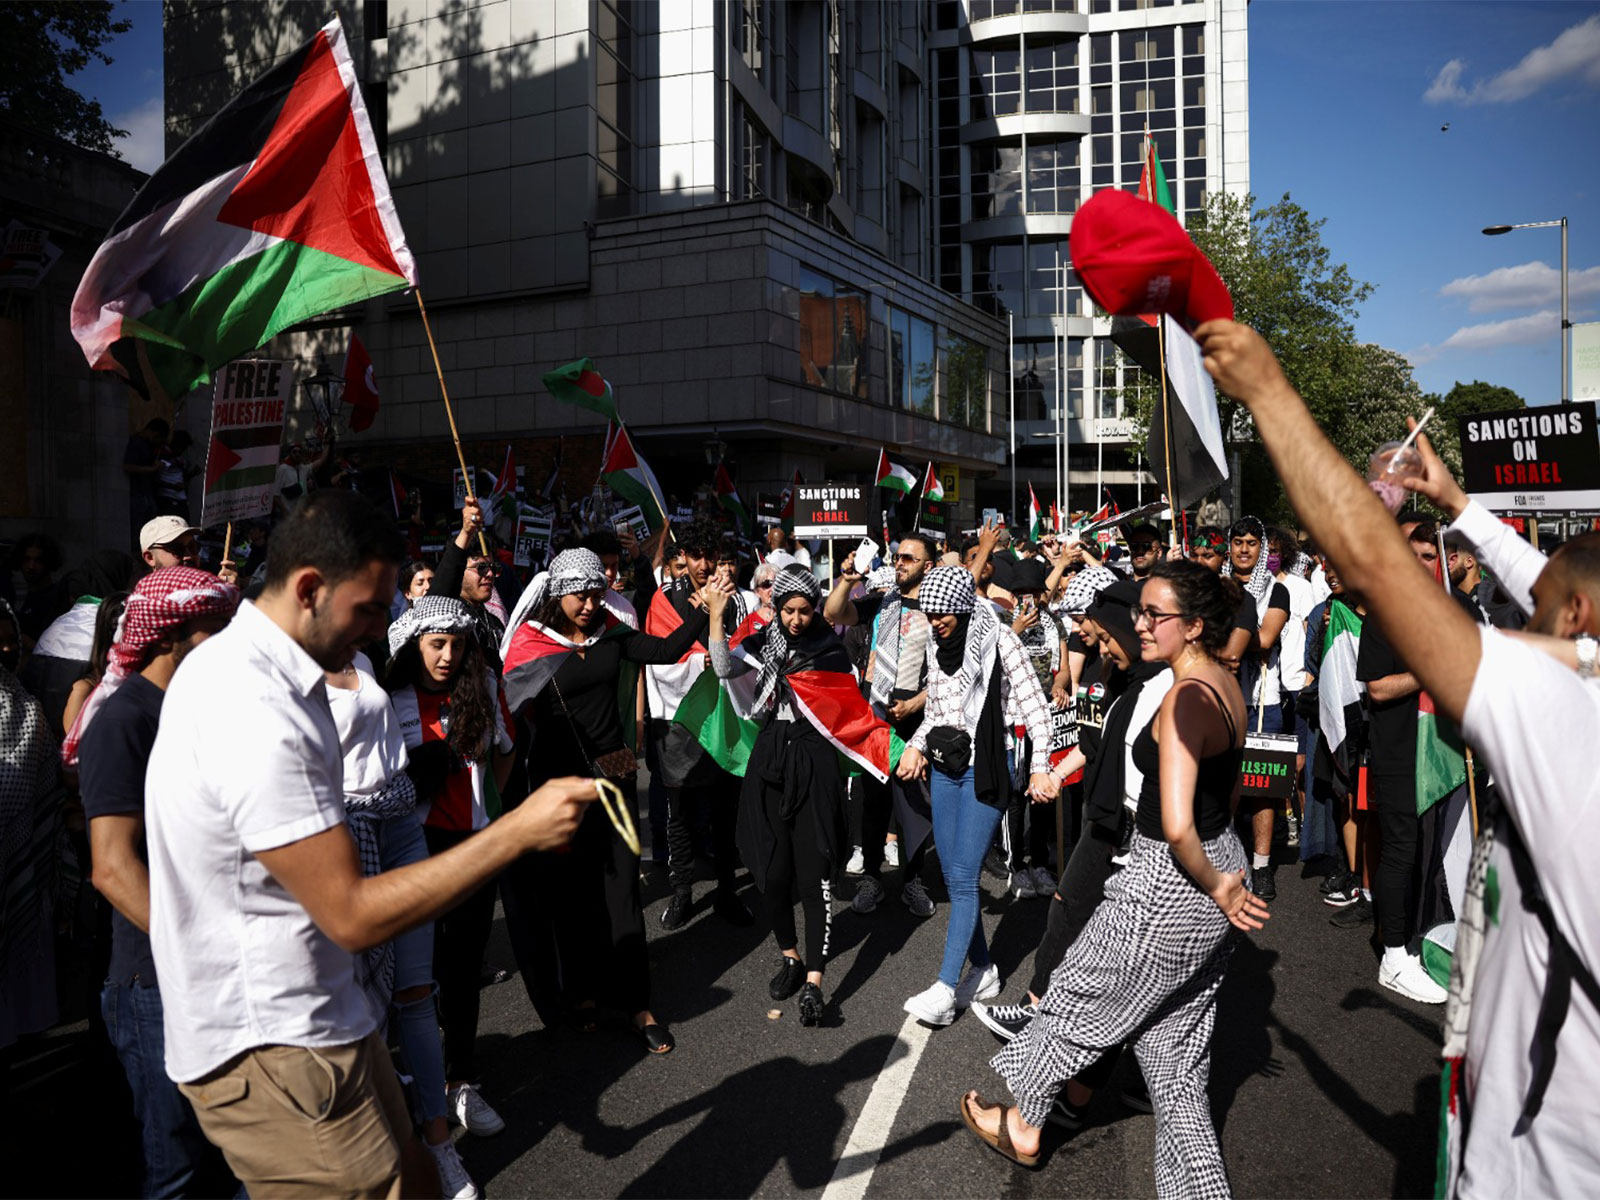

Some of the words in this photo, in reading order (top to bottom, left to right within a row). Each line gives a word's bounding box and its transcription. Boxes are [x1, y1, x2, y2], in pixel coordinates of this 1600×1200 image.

[224, 363, 281, 398] FREE
[214, 400, 283, 426] PALESTINE
[1467, 411, 1583, 442] SANCTIONS
[1512, 439, 1538, 462] ON
[1494, 462, 1562, 485] ISRAEL
[799, 487, 861, 500] SANCTIONS
[823, 499, 838, 511] ON
[811, 511, 850, 523] ISRAEL
[635, 527, 650, 541] EE
[517, 537, 548, 550] FREE
[1053, 729, 1080, 749] ESTINE
[1241, 761, 1288, 776] PALESTI
[1242, 774, 1270, 788] FREE
